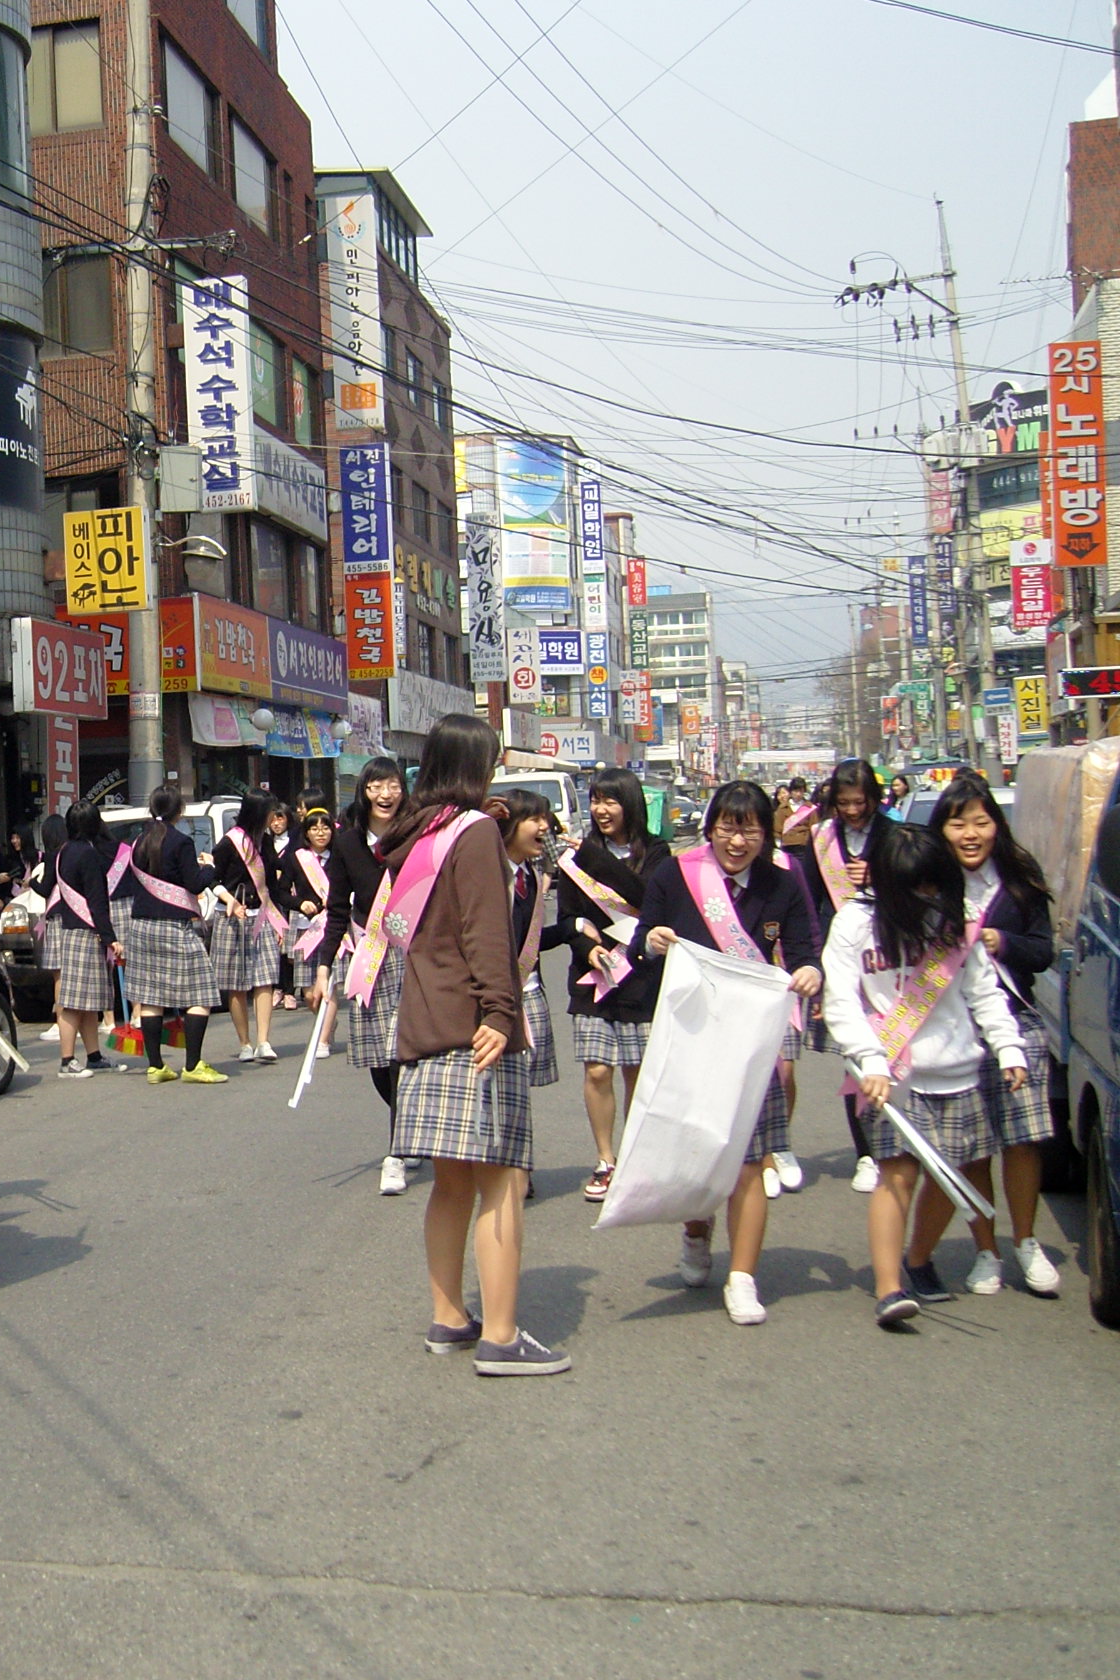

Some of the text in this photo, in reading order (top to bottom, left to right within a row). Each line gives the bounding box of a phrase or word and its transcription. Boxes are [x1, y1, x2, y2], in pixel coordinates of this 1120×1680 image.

[205, 492, 252, 509] 452-2167
[71, 522, 93, 578] 베이스
[95, 510, 140, 609] 피아노
[354, 587, 385, 665] 김밥천국
[1019, 679, 1041, 730] 사진실
